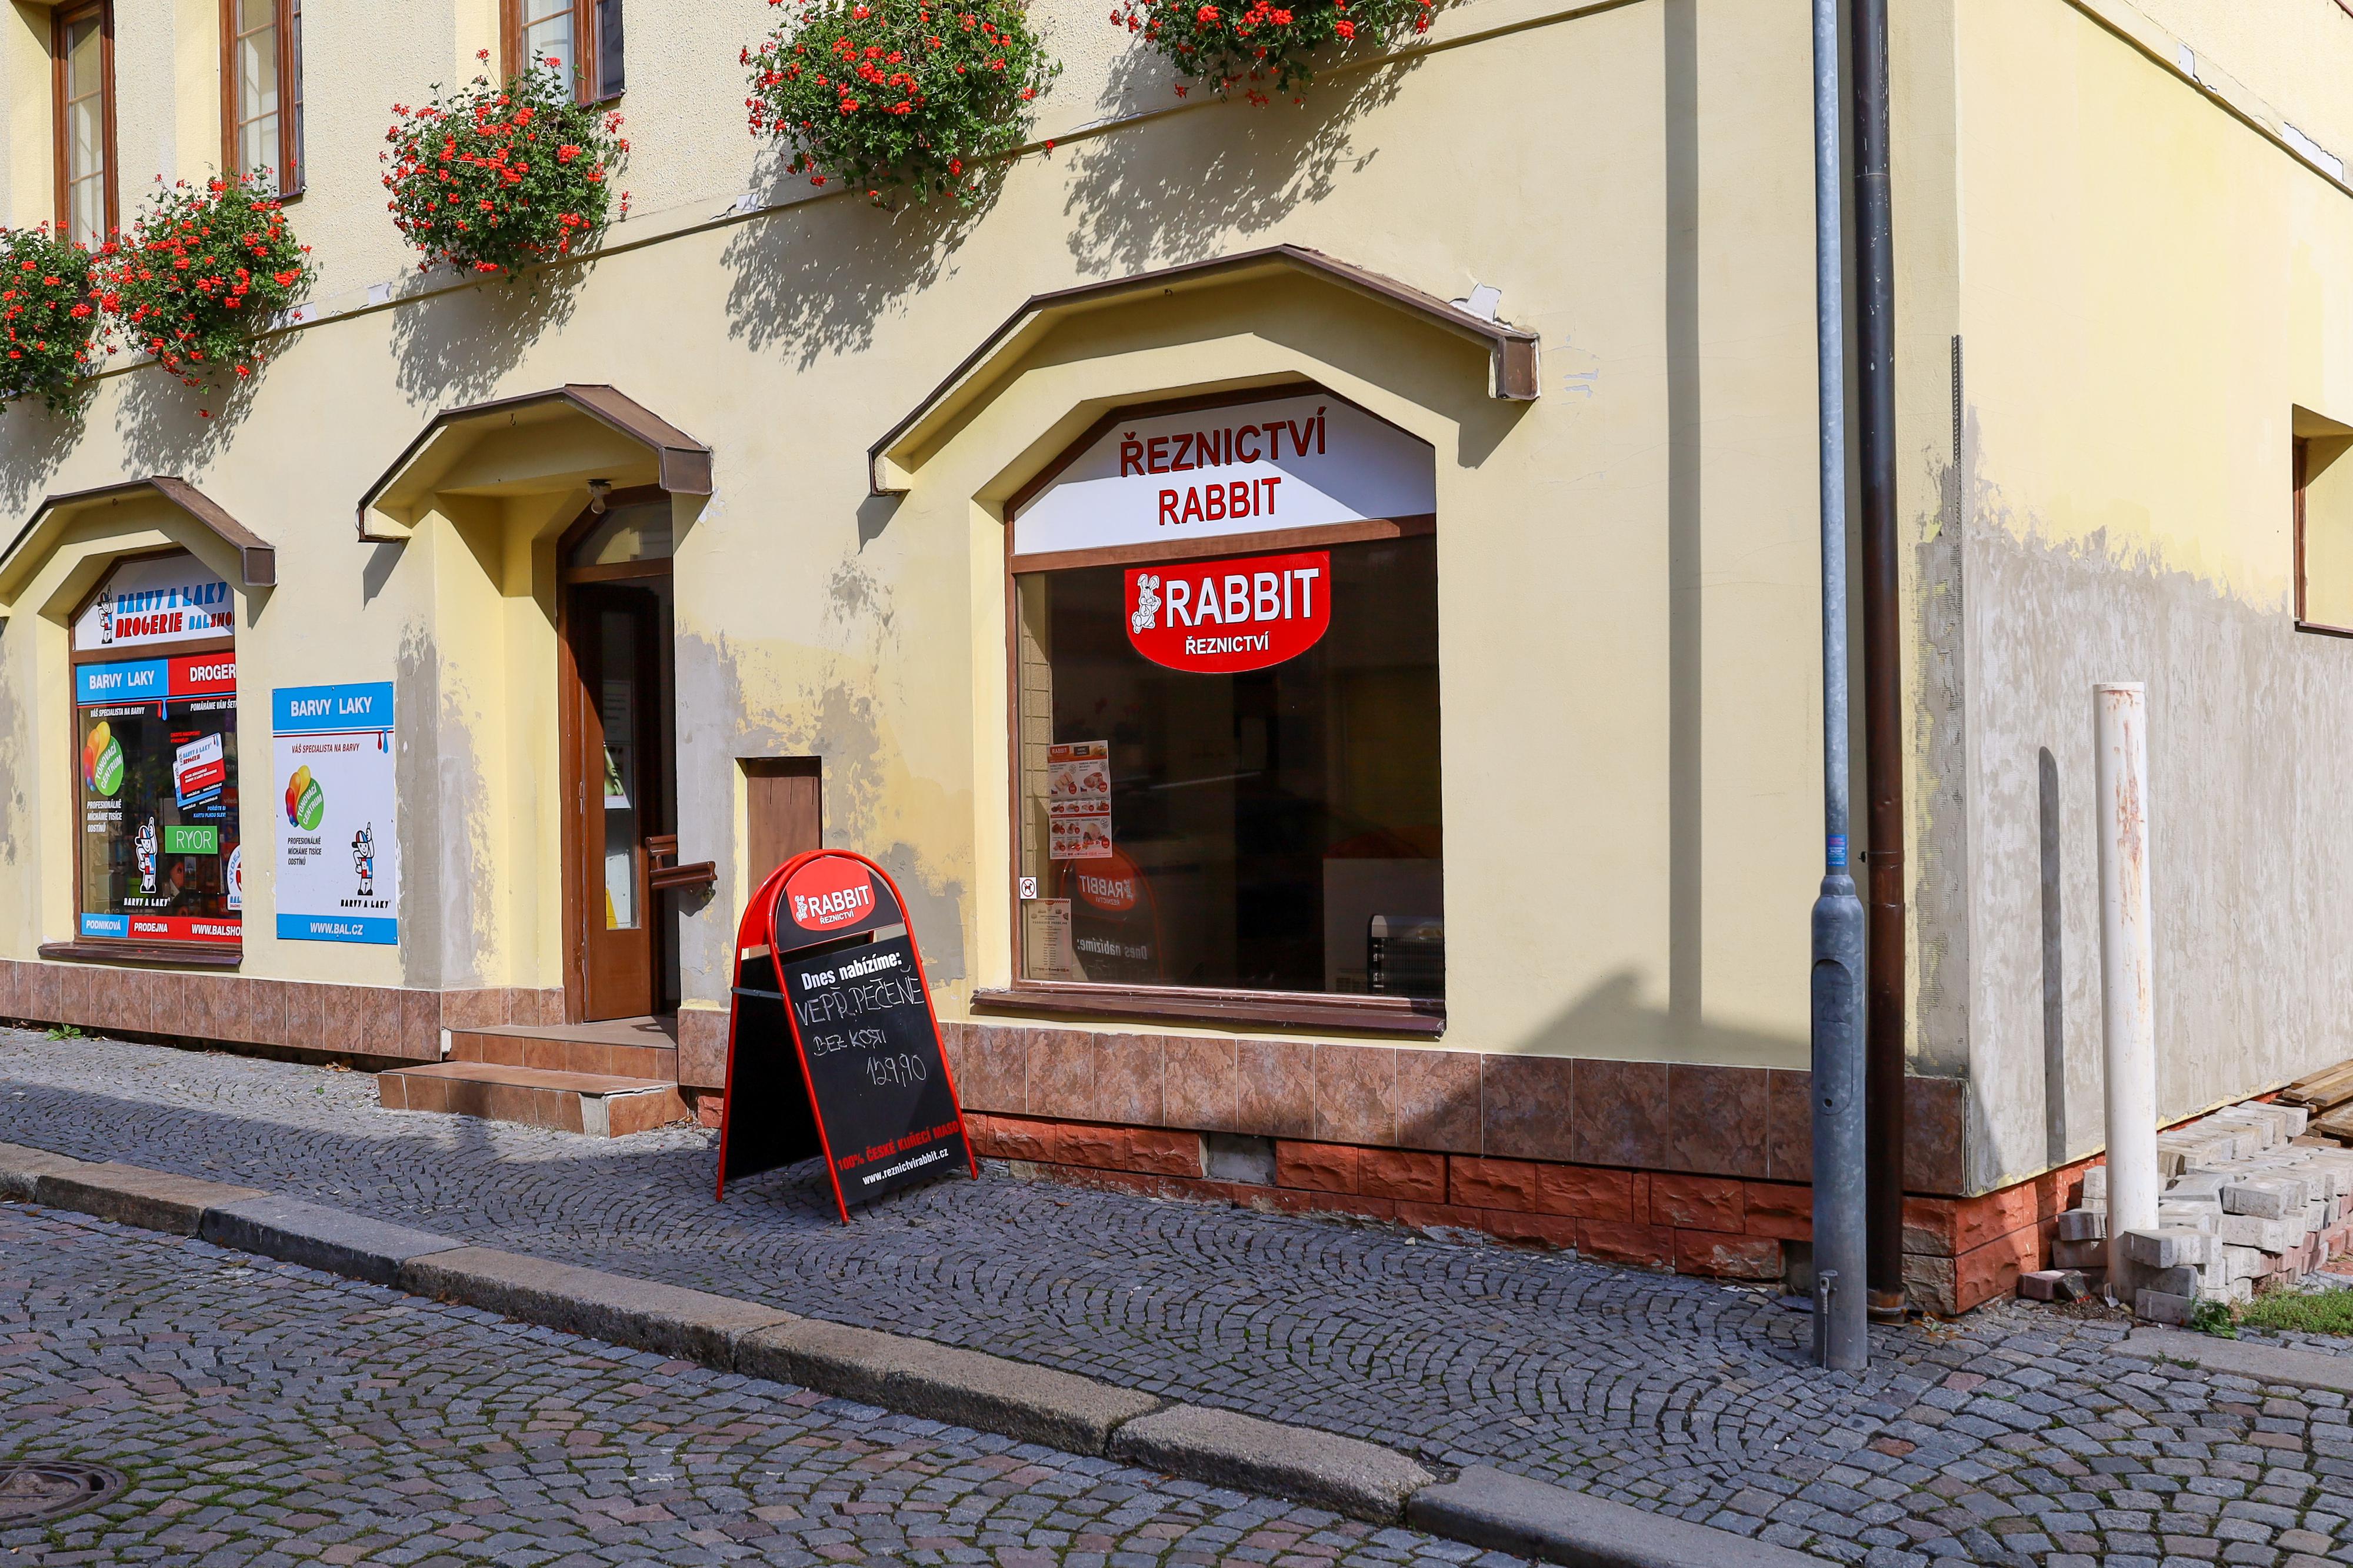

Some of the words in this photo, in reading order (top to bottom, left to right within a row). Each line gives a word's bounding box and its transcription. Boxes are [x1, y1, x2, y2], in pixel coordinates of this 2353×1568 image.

[1120, 406, 1327, 478] ŘEZNICTVÍ
[1159, 477, 1281, 525] RABBIT
[117, 589, 164, 614] BARVY
[168, 588, 176, 609] A
[182, 581, 228, 607] LAKY
[1166, 568, 1319, 628] RABBIT
[115, 612, 183, 638] DROGERIE
[1185, 631, 1269, 655] ŘEZNICTVÍ
[89, 673, 122, 689] BARVY
[128, 670, 155, 686] LAKY
[91, 708, 99, 718] VÁŠ
[99, 708, 124, 717] SPECIALISTA
[124, 708, 130, 716] NA
[131, 707, 145, 715] BARVY
[216, 699, 226, 709] VÁM
[291, 698, 332, 717] BARVY
[339, 696, 372, 715] LAKY
[292, 743, 302, 753] VÁŠ
[302, 744, 332, 753] SPECIALISTA
[334, 744, 341, 752] NA
[342, 743, 359, 752] BARVY
[101, 755, 122, 789] CENTRUM
[86, 799, 122, 809] PROFESIONÁLNĚ
[302, 795, 323, 825] CENTRUM
[87, 810, 108, 821] MÍCHÁME
[108, 810, 122, 820] TISÍCE
[176, 830, 212, 849] RYOR
[288, 835, 321, 845] PROFESIONÁLNĚ
[288, 846, 308, 855] MÍCHÁME
[308, 847, 322, 855] TISÍCE
[124, 898, 144, 906] BARVY
[145, 898, 149, 906] A
[151, 898, 169, 906] LAKY
[341, 899, 362, 908] BARVY
[371, 900, 389, 909] LAKY
[807, 885, 870, 918] RABBIT
[86, 919, 121, 930] PODNIKOVÁ
[819, 909, 855, 925] ŘEZNICTVÍ
[134, 922, 168, 933] PRODEJNA
[310, 922, 364, 936] WWW.BAL.CZ
[801, 970, 836, 990] Dnes
[838, 952, 902, 981] nabízíme:
[813, 1034, 848, 1056] BEZ
[849, 1028, 887, 1049] KOSTI
[837, 1152, 864, 1171] 100%
[866, 1139, 896, 1162] ČESKÉ
[897, 1126, 931, 1151] KUŘECÍ
[932, 1120, 960, 1139] MASO
[862, 1148, 949, 1185] www.reznictvirabbit.cz
